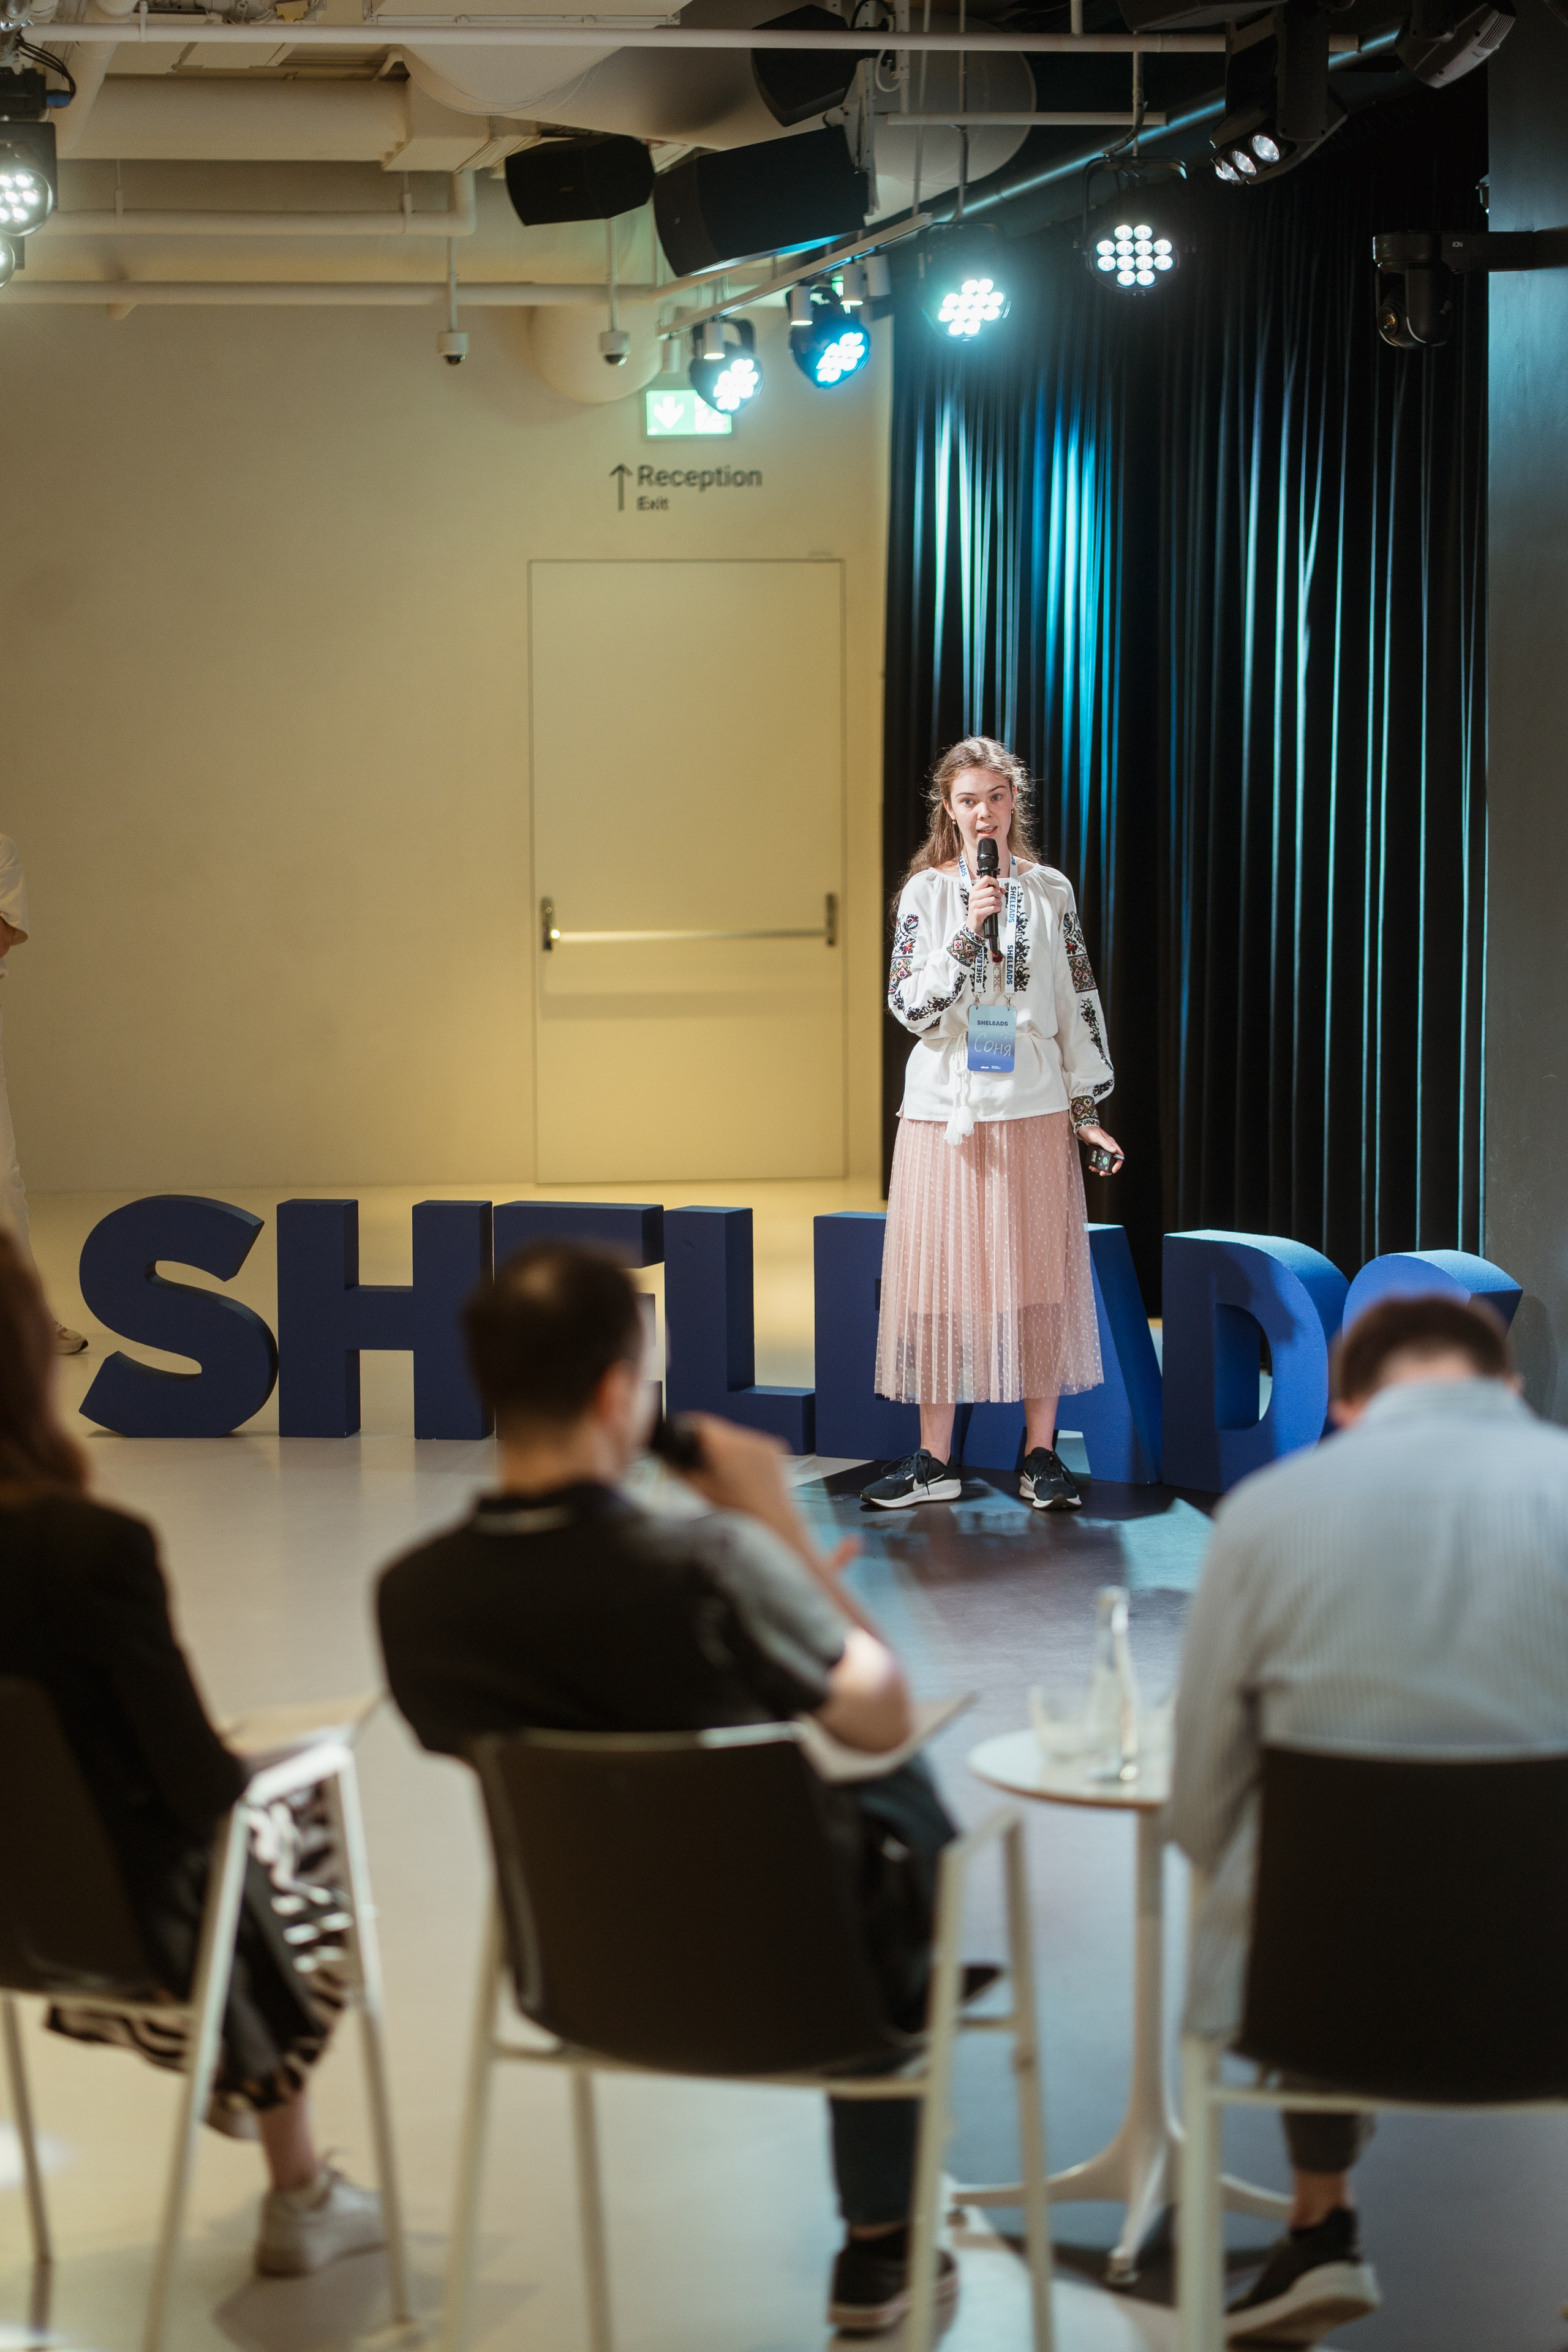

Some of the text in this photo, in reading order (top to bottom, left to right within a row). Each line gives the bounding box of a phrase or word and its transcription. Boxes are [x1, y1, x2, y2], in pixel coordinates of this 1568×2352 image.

[638, 464, 763, 492] Reception
[638, 496, 669, 511] Exit
[958, 854, 967, 877] LEADS
[1008, 886, 1017, 923] SHELEADS
[974, 1032, 1012, 1057] Соня
